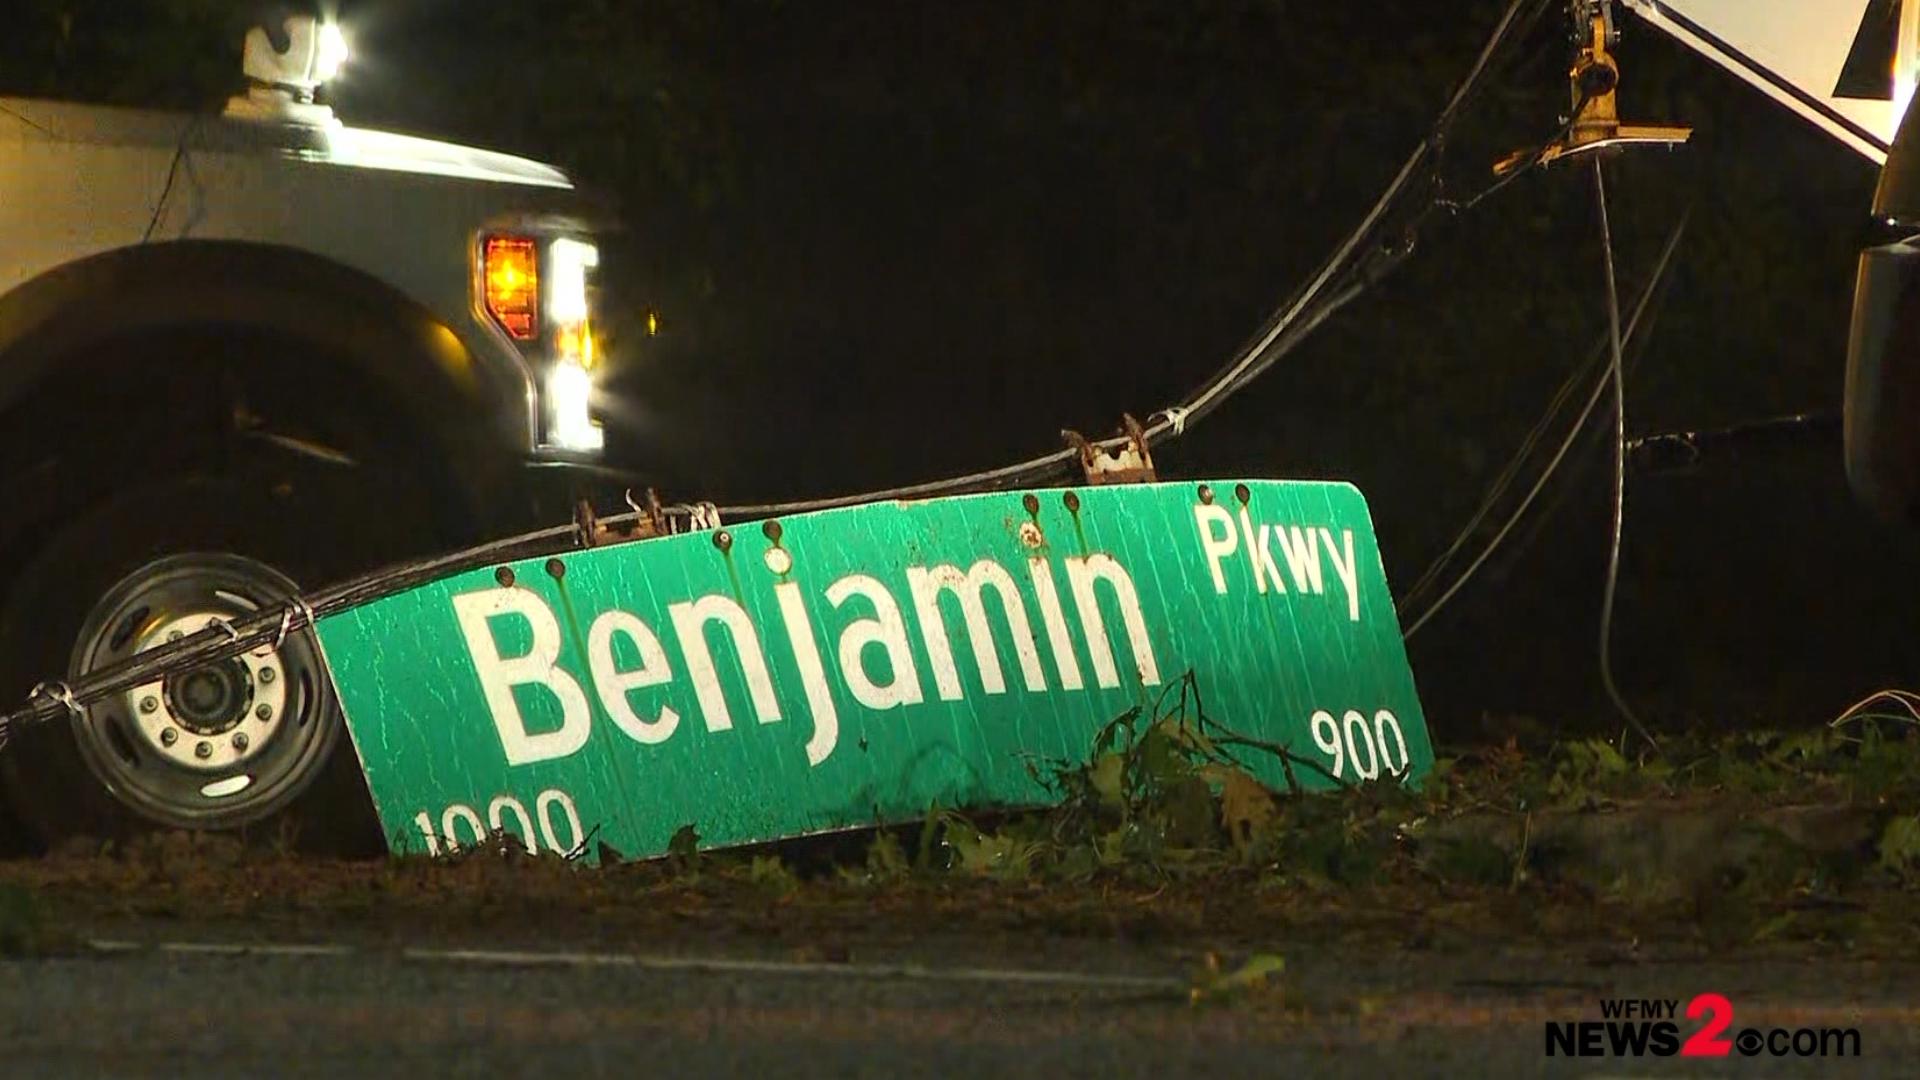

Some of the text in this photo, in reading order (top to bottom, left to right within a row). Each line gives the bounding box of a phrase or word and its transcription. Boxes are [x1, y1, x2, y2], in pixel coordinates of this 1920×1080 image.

[451, 504, 1360, 767] Benjamin Pkwy
[1310, 710, 1410, 782] 900
